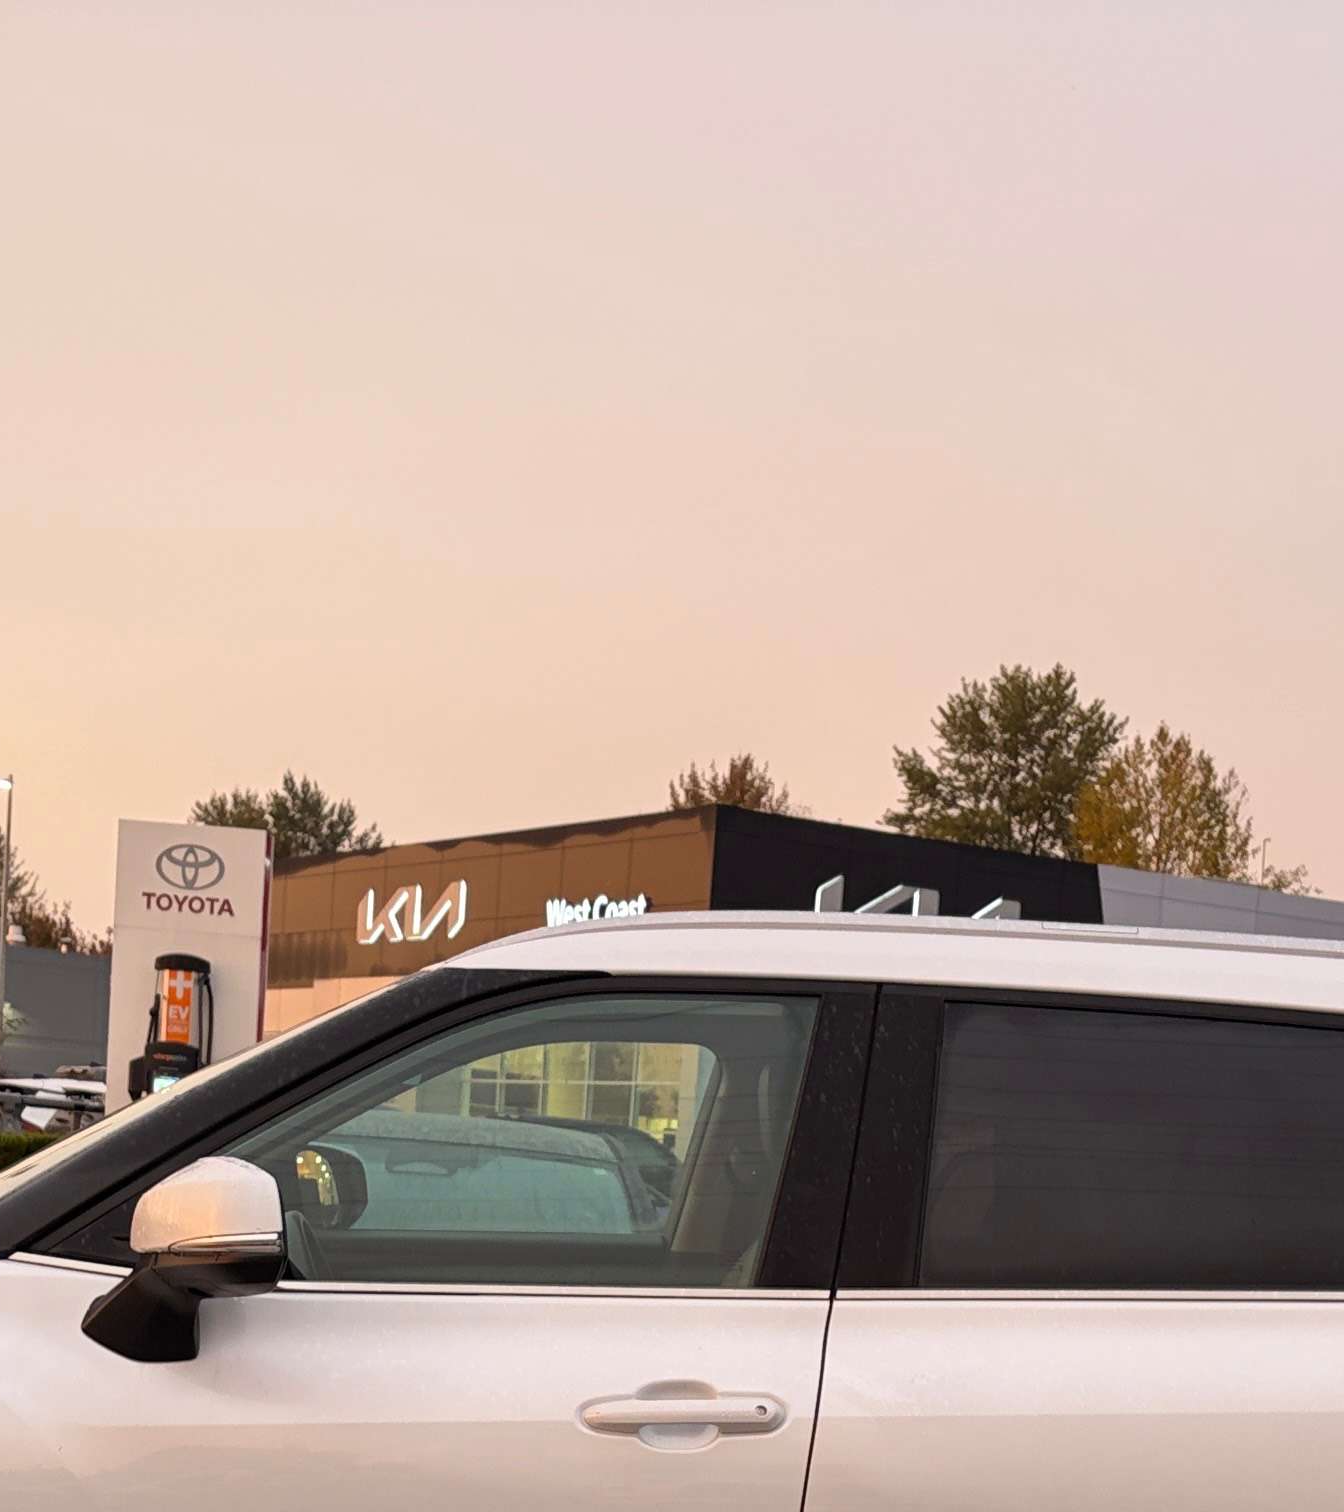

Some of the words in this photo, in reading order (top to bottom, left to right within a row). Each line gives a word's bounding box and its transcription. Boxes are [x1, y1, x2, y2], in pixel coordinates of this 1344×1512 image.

[141, 891, 235, 917] TOYOTA
[357, 879, 467, 944] KIA
[546, 898, 591, 928] West
[593, 893, 647, 920] Coast
[169, 1005, 190, 1020] EV
